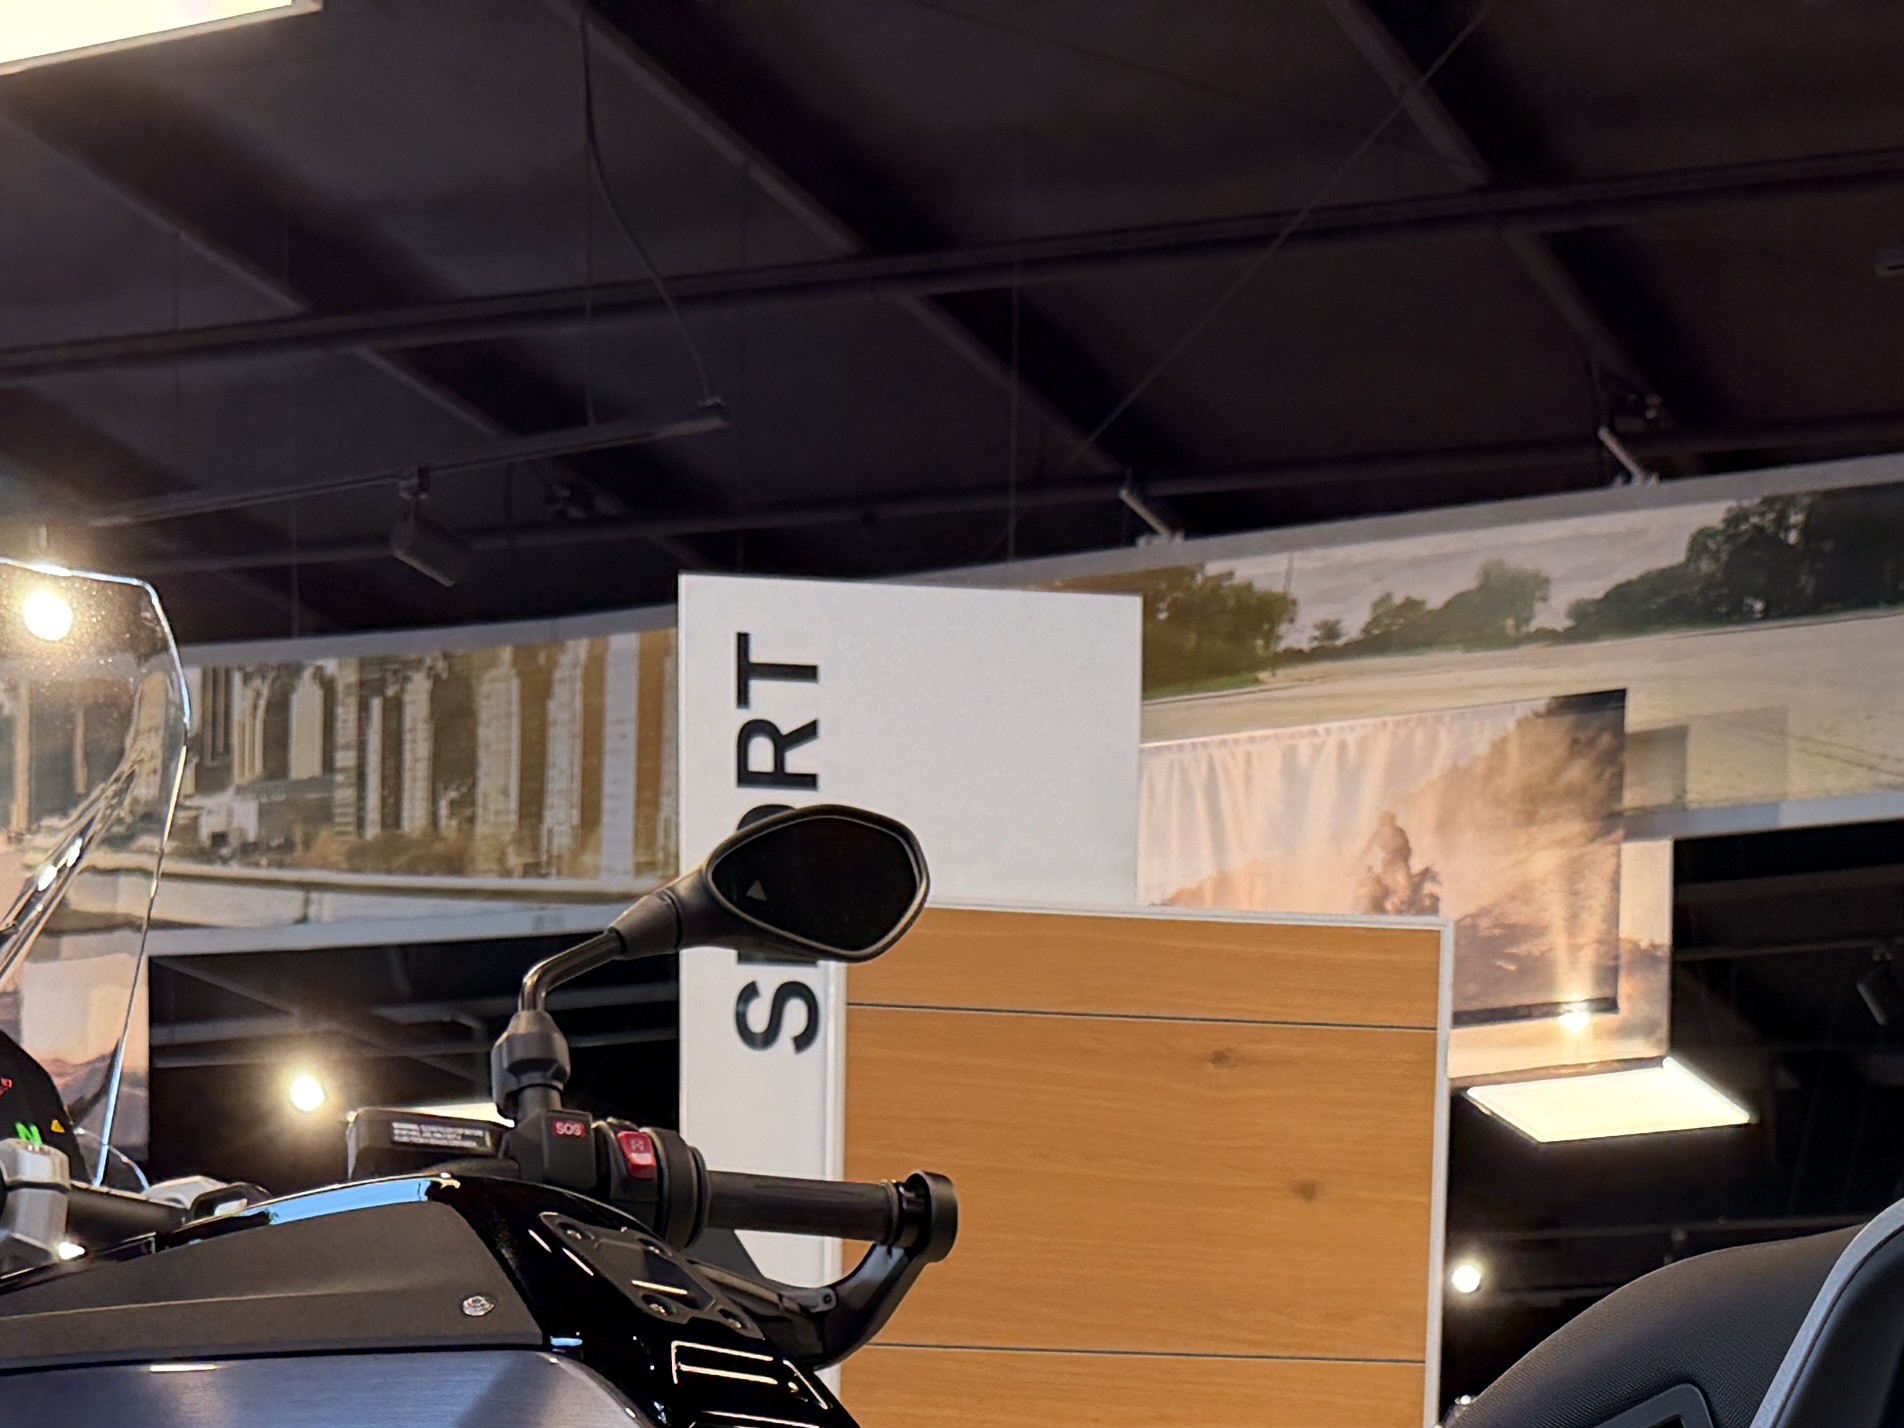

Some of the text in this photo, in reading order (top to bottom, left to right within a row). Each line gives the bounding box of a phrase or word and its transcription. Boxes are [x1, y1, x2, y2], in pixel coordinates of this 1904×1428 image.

[736, 630, 820, 1053] SRT
[14, 1121, 44, 1147] N
[555, 1120, 586, 1138] SOS
